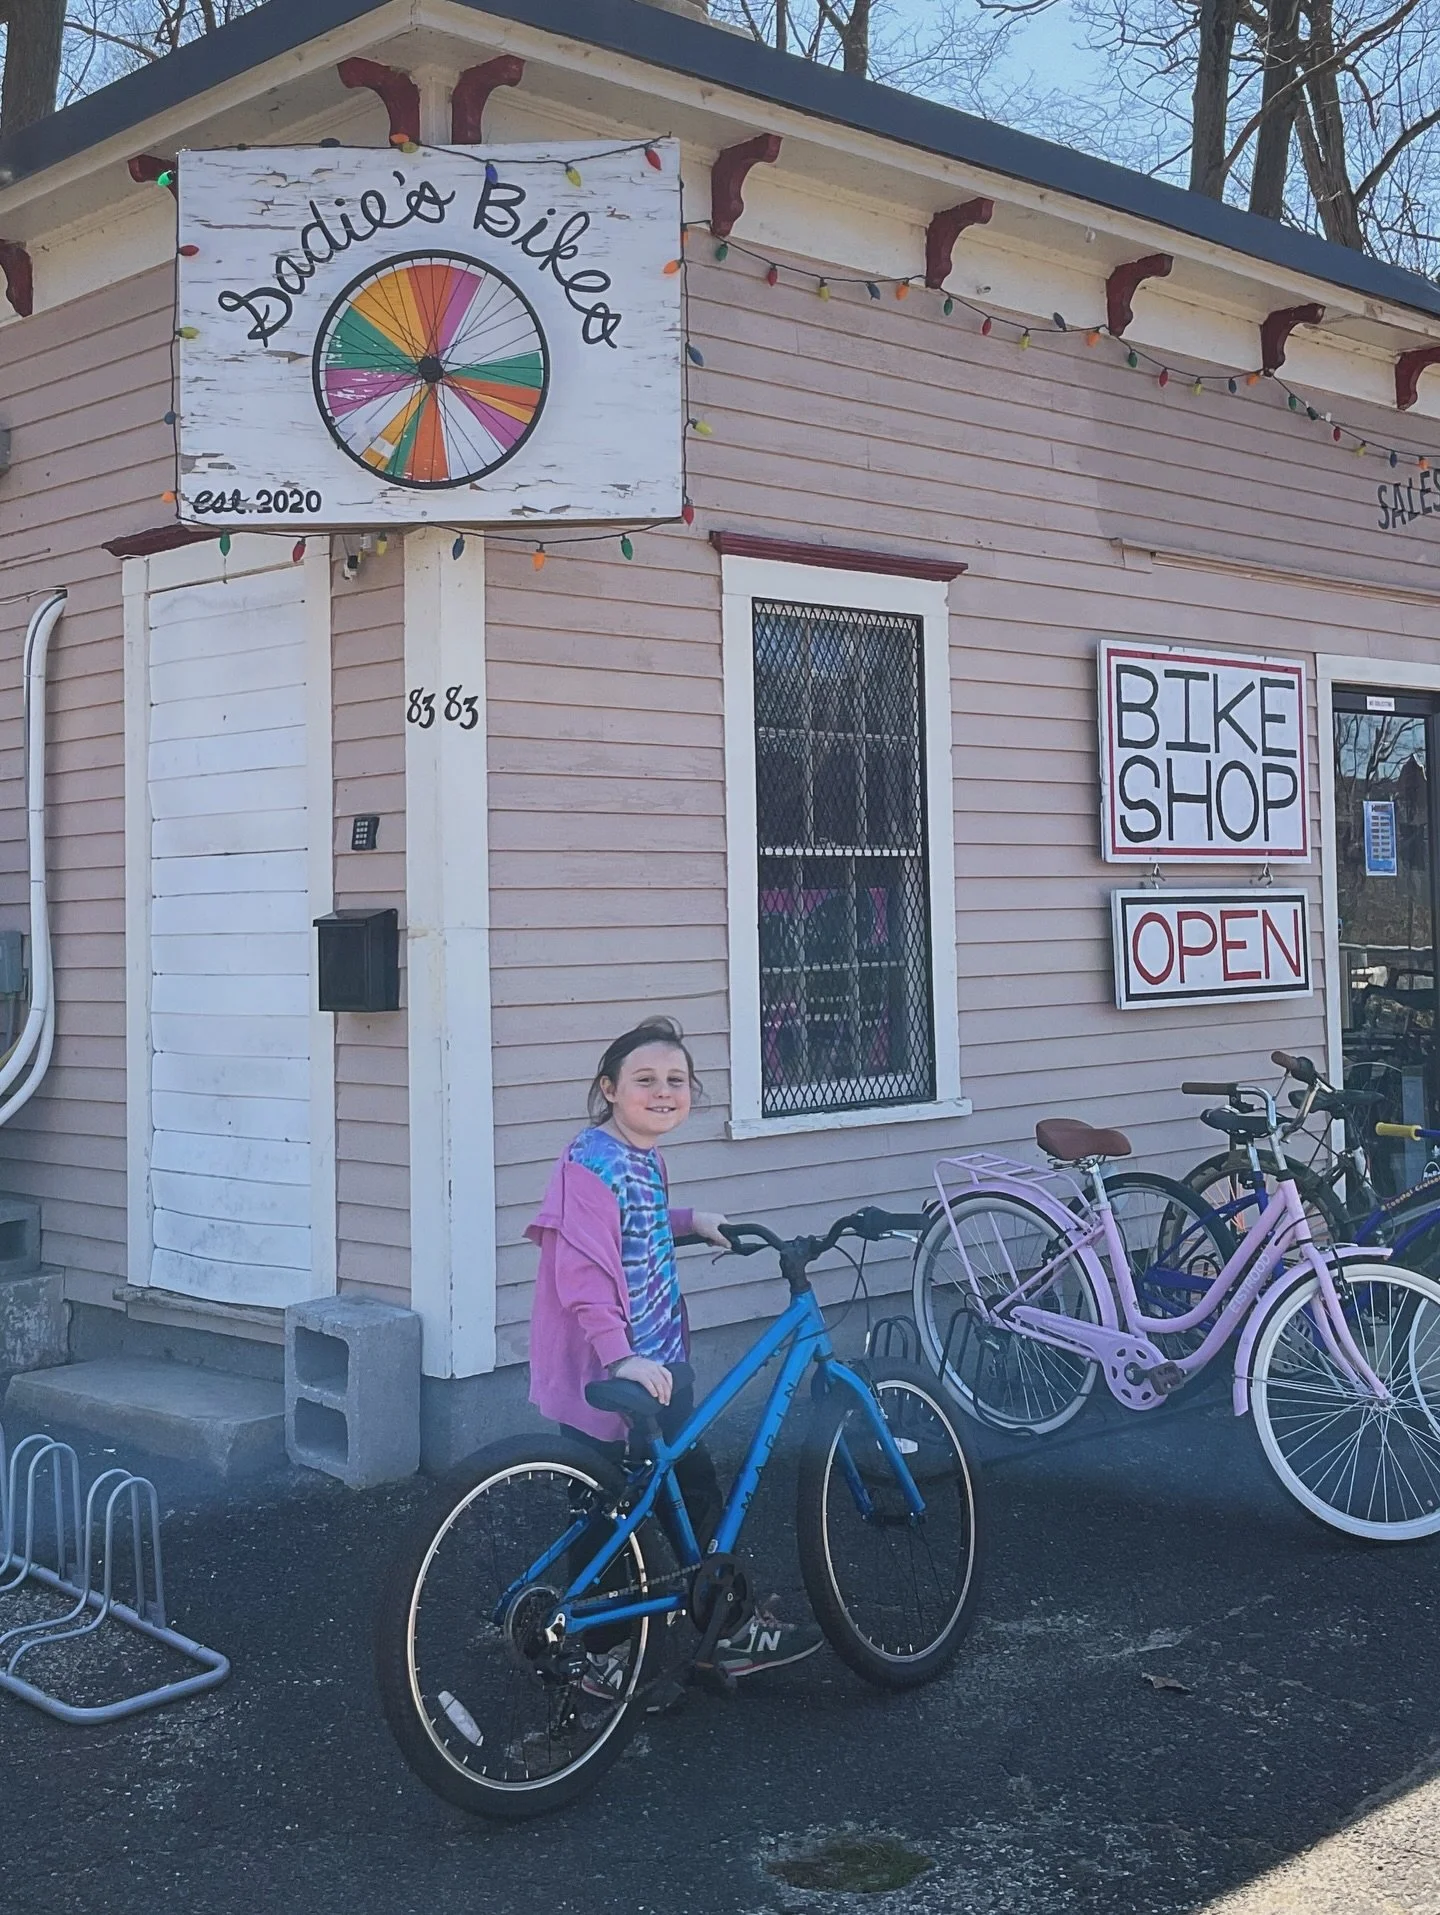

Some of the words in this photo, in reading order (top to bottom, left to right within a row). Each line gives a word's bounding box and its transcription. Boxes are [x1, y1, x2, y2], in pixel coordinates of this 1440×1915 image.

[218, 170, 456, 348] Sadie's
[473, 182, 622, 349] Bikes
[256, 489, 322, 513] 2020
[407, 687, 436, 729] 83
[444, 684, 479, 730] 83
[1116, 664, 1297, 758] BIKE
[1118, 754, 1298, 844] SHOP
[1131, 908, 1302, 986] OPEN
[757, 1631, 781, 1651] N
